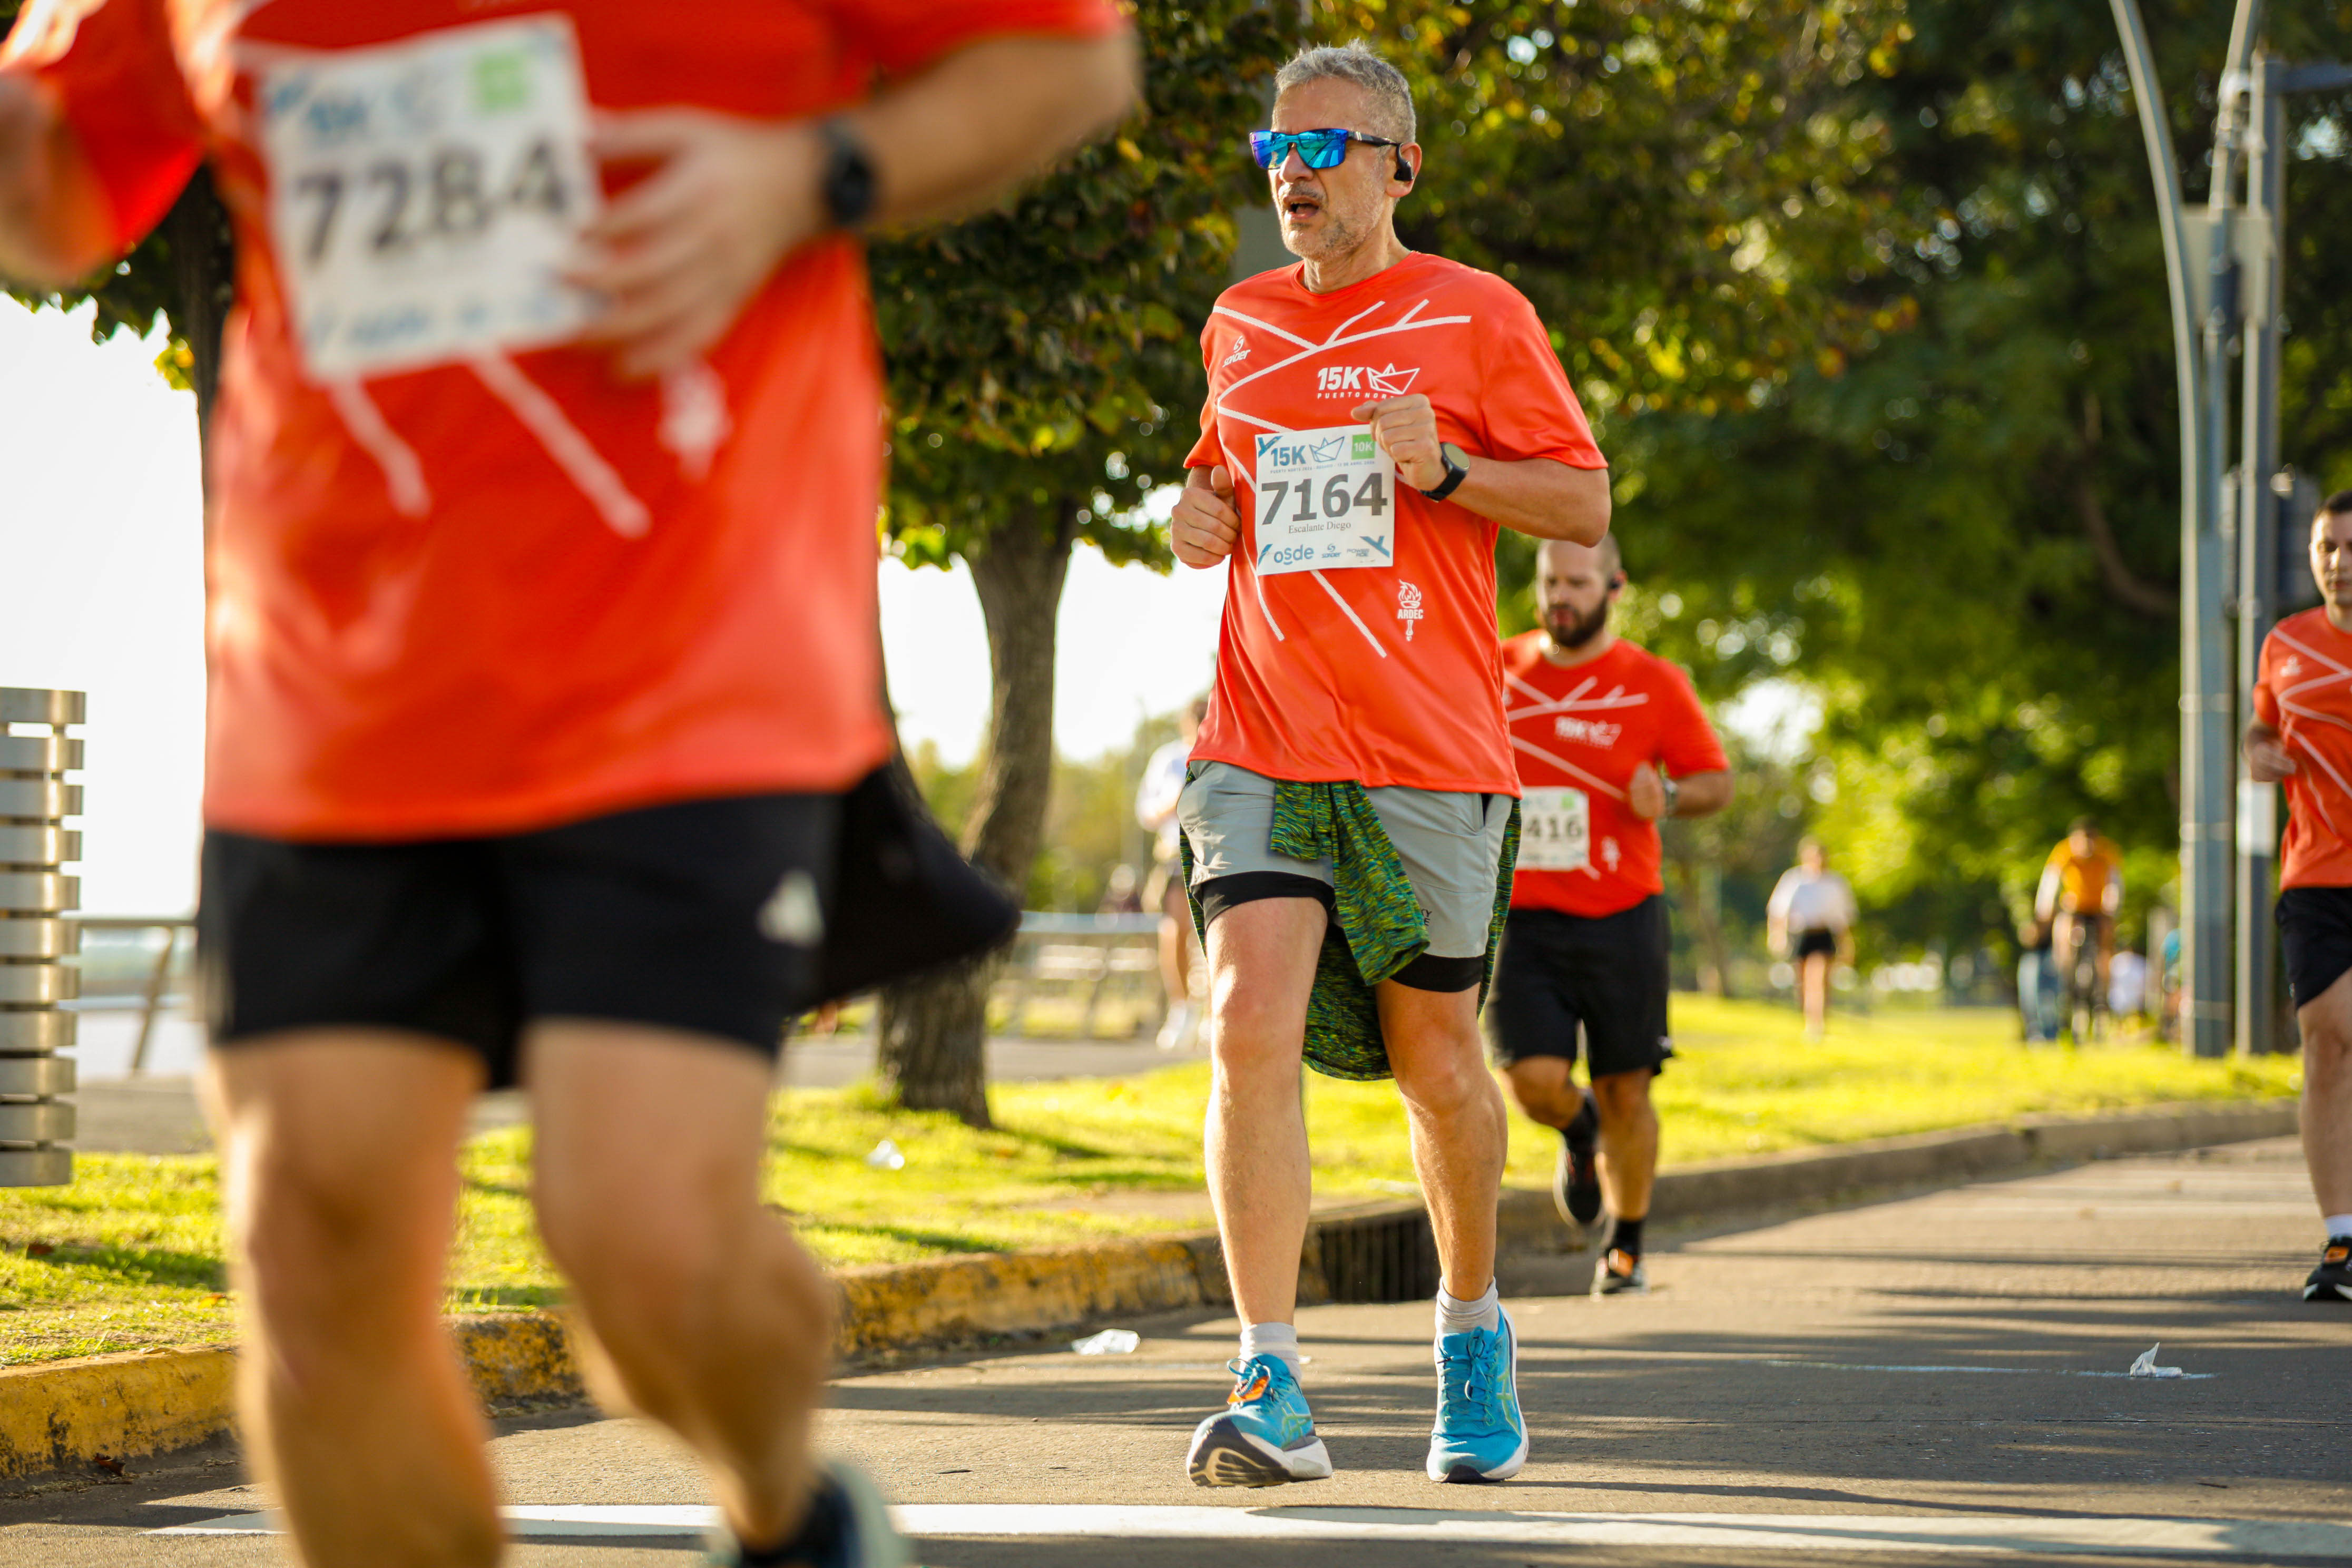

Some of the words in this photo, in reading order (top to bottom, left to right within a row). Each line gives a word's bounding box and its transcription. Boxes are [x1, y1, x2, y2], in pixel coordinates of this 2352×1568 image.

[1318, 366, 1365, 390] 15K
[1271, 445, 1307, 467] 15K
[1354, 442, 1374, 452] 10K
[1261, 472, 1388, 525] 7164
[1288, 523, 1325, 534] Escalante
[1327, 520, 1351, 531] Diego
[1273, 544, 1314, 564] osde
[1397, 609, 1424, 619] ARDEC
[1526, 815, 1583, 841] 416
